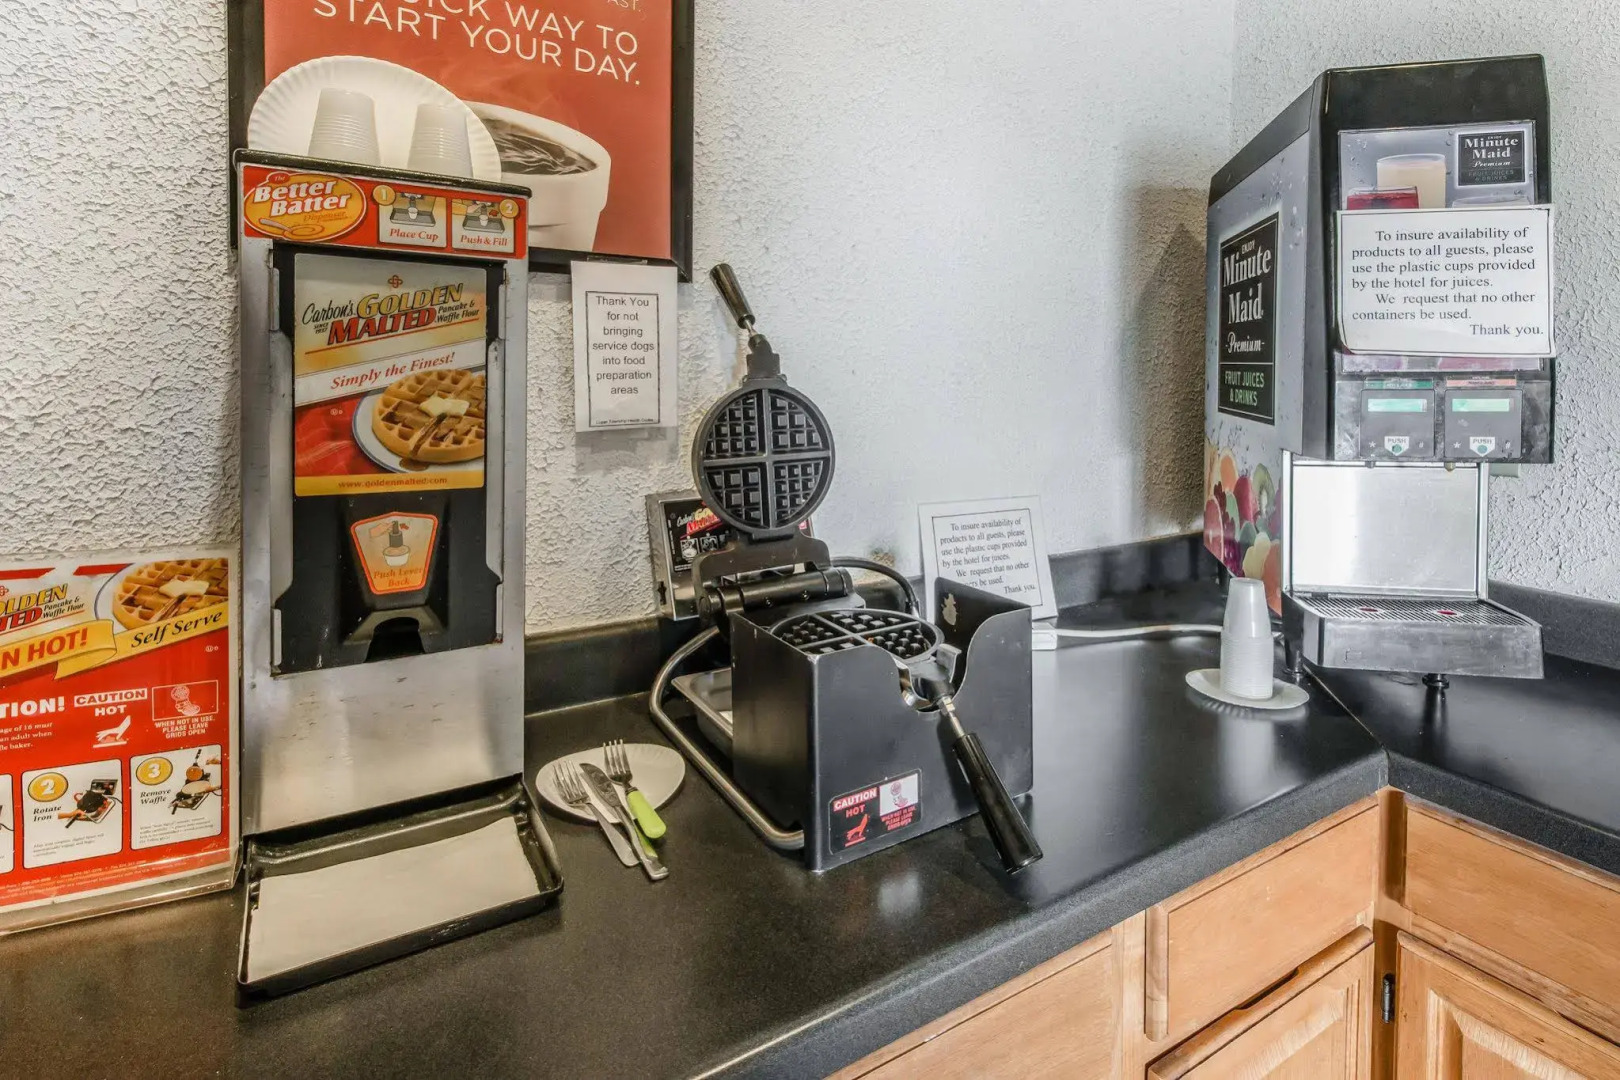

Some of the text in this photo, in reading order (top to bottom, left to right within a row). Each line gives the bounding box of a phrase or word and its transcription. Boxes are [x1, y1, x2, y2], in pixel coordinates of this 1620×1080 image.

[505, 1, 584, 42] WAY
[596, 24, 638, 56] TO
[314, 0, 446, 40] START
[460, 21, 562, 67] YOUR
[575, 47, 641, 85] DAY.
[1464, 138, 1519, 148] Minute
[1473, 147, 1510, 159] Maid
[254, 180, 338, 203] Better
[381, 189, 387, 200] 1
[270, 194, 352, 217] Batter
[506, 203, 513, 214] 2
[389, 228, 438, 242] Place Cup
[460, 234, 482, 244] Push
[493, 238, 508, 246] Fill
[1376, 227, 1530, 242] To insure availability of
[1352, 244, 1534, 260] products to all guests, please
[1223, 248, 1272, 287] Minute
[1352, 260, 1535, 275] use the plastic cups provided
[1352, 276, 1493, 291] by the hotel for juices.
[302, 283, 464, 325] Carbon's GOLDEN
[596, 296, 649, 307] Thank You
[1228, 282, 1264, 324] Maid
[1376, 292, 1536, 307] We request that no other
[438, 302, 467, 313] Pancake
[1352, 308, 1472, 320] containers be used.
[437, 310, 480, 323] Waffle Flour
[607, 312, 639, 321] for not
[327, 306, 437, 345] MALTED
[603, 326, 643, 338] bringing
[1470, 324, 1544, 337] Thank you.
[592, 341, 654, 352] service dogs
[602, 356, 646, 365] into food
[331, 352, 455, 390] Simply the Finest!
[596, 370, 652, 382] preparation
[1225, 370, 1264, 388] FRUIT JUICES
[610, 386, 639, 394] areas
[1230, 390, 1258, 406] & DRINKS
[338, 477, 447, 488] www.goldenmalted.com
[981, 519, 1013, 528] availability
[940, 535, 967, 545] products
[1007, 530, 1025, 538] please
[965, 545, 985, 554] plastic
[1002, 540, 1027, 550] provided
[942, 560, 950, 569] by
[970, 567, 992, 576] request
[1015, 561, 1029, 569] other
[1004, 585, 1023, 594] Thank
[0, 583, 68, 615] OLDEN
[44, 599, 72, 611] Pancake
[43, 603, 84, 618] Waffle Flour
[0, 607, 43, 632] TED
[131, 612, 222, 648] Self Serve
[28, 628, 88, 661] HOT!
[76, 690, 146, 705] CAUTION
[0, 696, 65, 719] TION!
[94, 705, 128, 717] HOT
[148, 764, 161, 778] 3
[40, 779, 55, 795] 2
[140, 788, 171, 798] Remove
[140, 796, 167, 805] Waffle
[834, 788, 877, 810] CAUTION
[33, 804, 62, 815] Rotate
[846, 805, 865, 818] HOT
[33, 813, 52, 822] Iron
